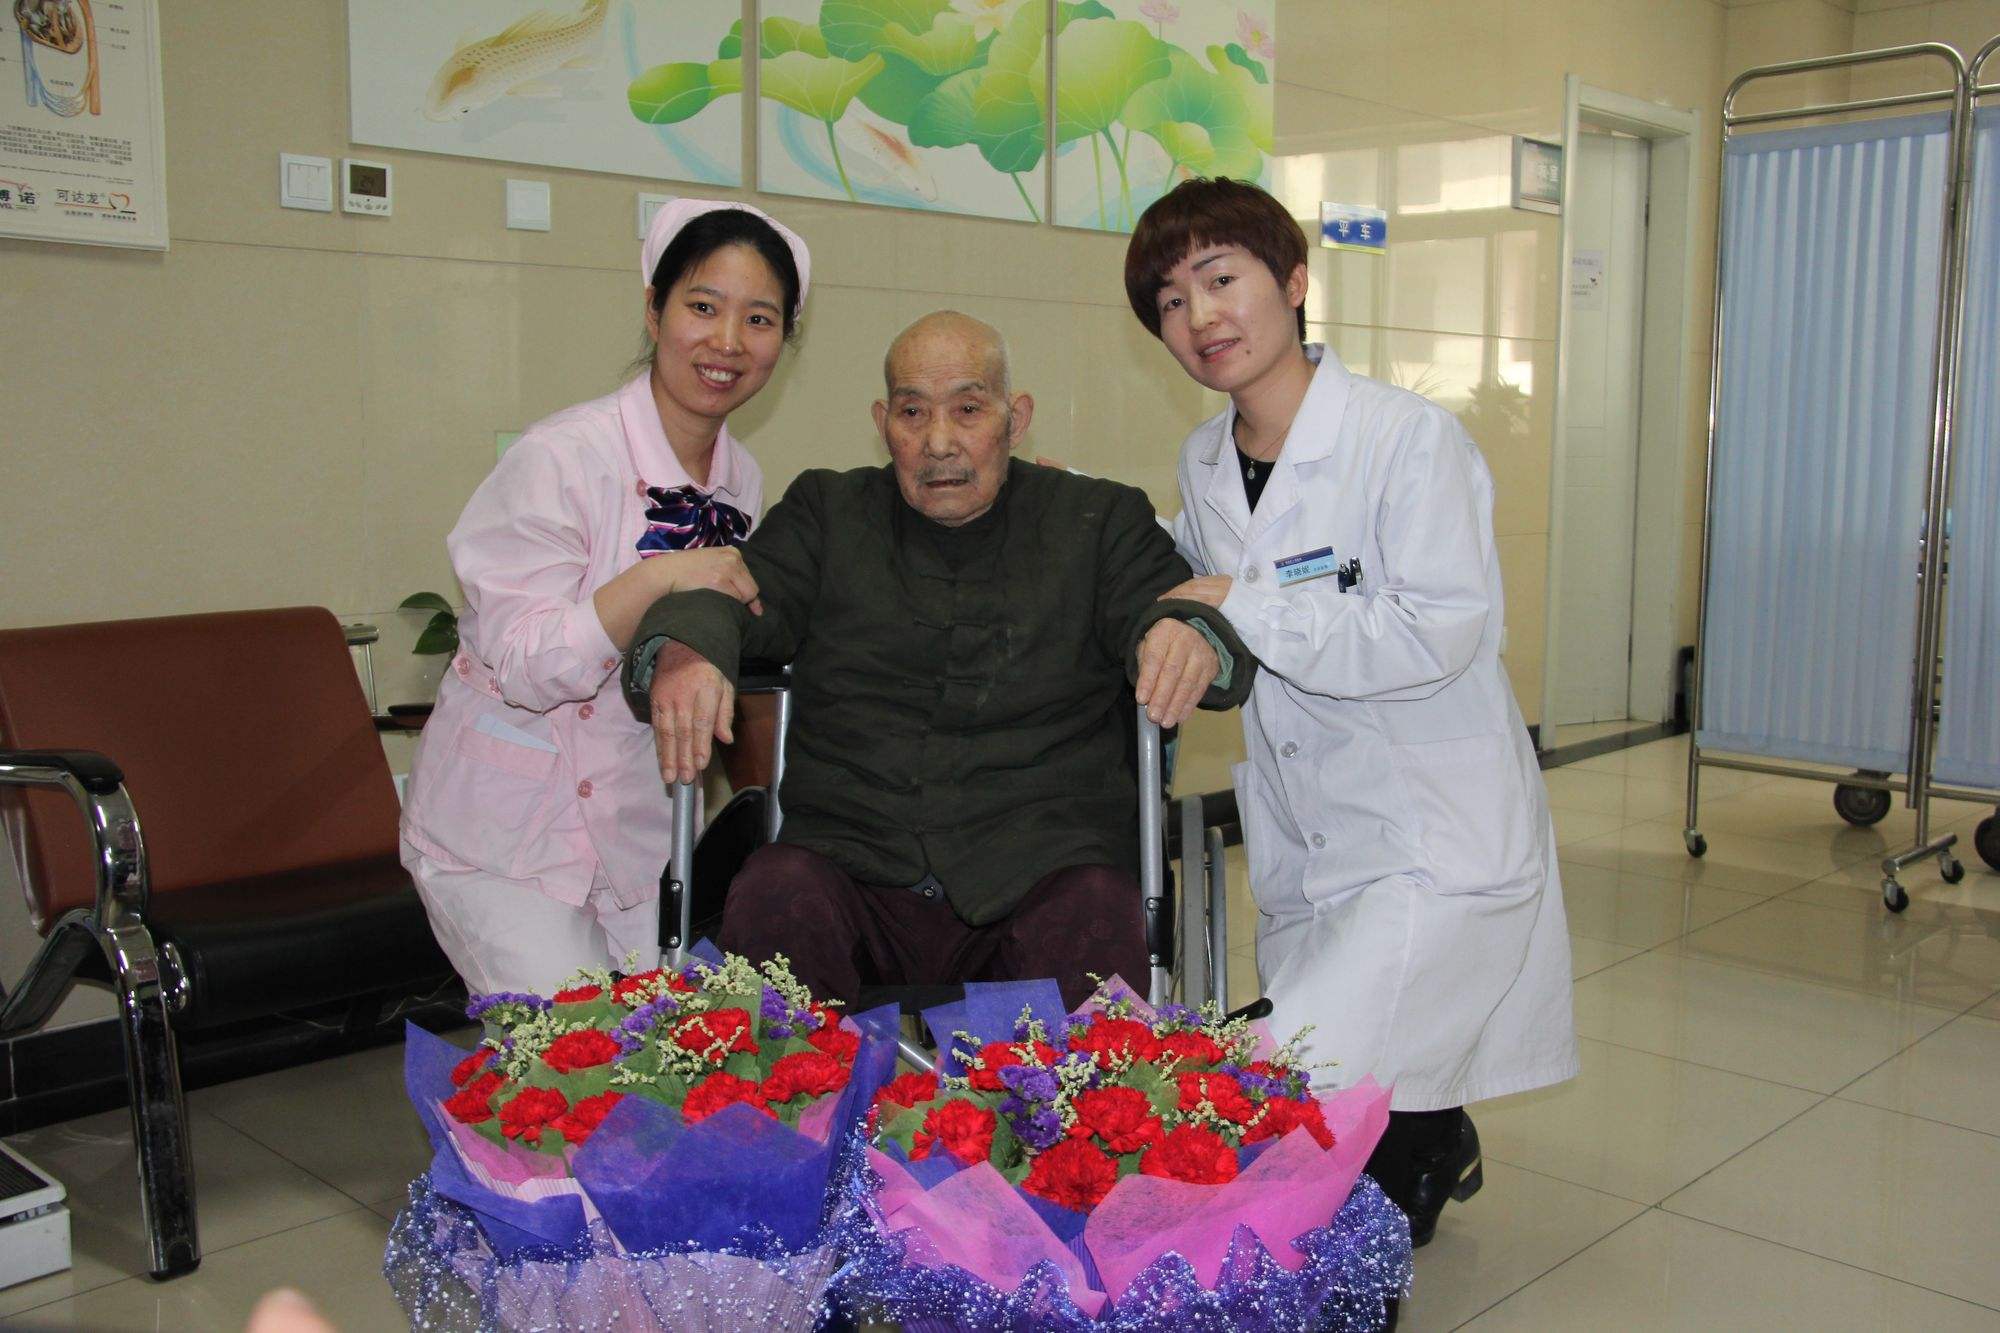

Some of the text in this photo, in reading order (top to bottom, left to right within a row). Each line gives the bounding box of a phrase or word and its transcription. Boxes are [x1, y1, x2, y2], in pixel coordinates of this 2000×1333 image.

[57, 189, 100, 205] 可达龙
[1338, 219, 1371, 240] 平车
